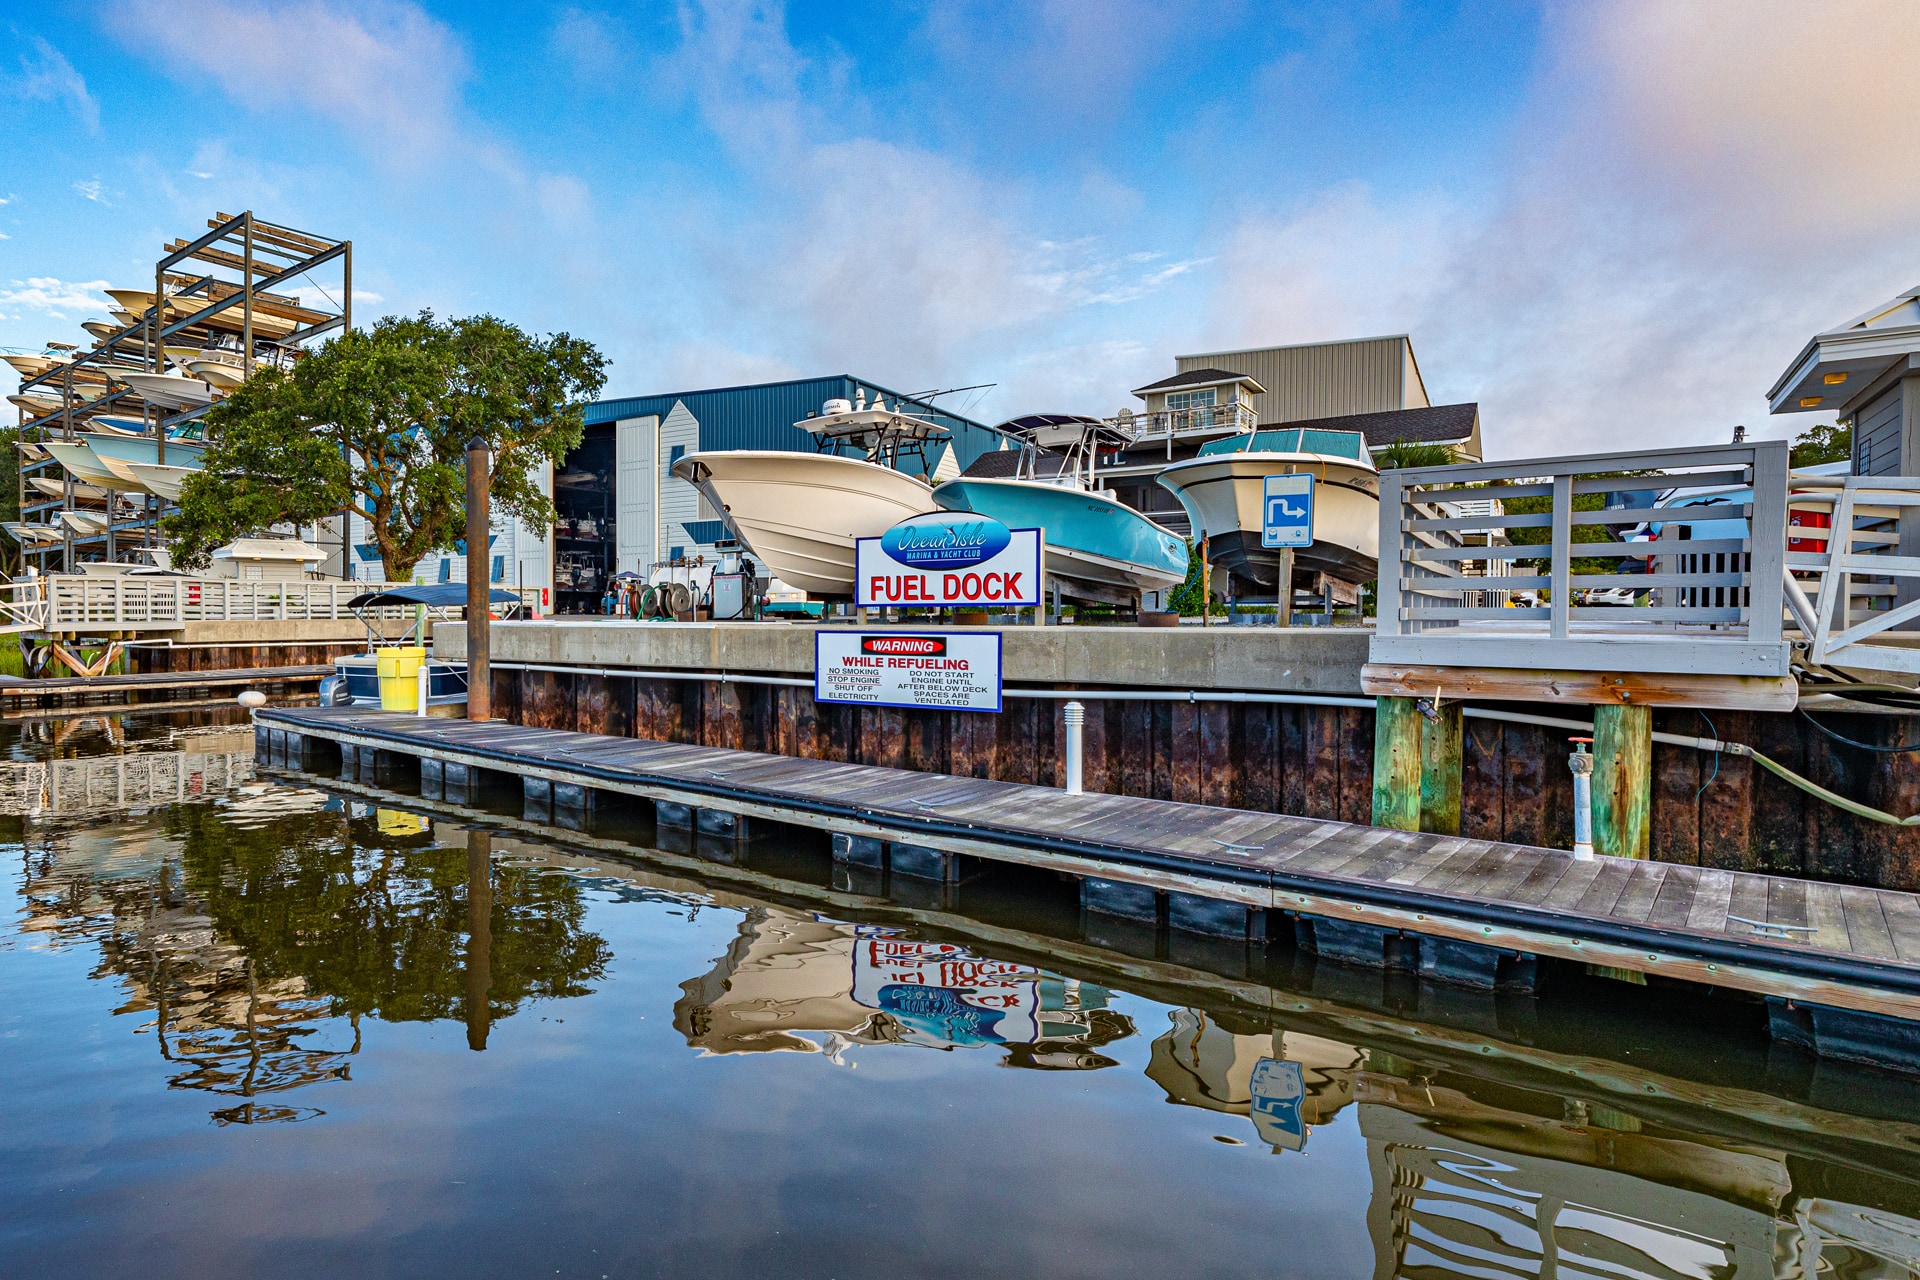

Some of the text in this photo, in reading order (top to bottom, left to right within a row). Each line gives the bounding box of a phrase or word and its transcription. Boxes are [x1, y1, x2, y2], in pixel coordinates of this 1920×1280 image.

[898, 521, 987, 550] Ocean Isle
[906, 549, 981, 560] MARINA & YACHT CLUB
[870, 572, 1023, 601] FUEL DOCK
[872, 640, 934, 652] WARNING
[842, 656, 969, 671] WHILE REFUELING
[850, 676, 880, 684] ENGINE
[944, 671, 975, 679] START
[927, 684, 960, 692] BELOW
[828, 692, 879, 700] ELECTRICITY
[914, 697, 969, 706] VENTILATED
